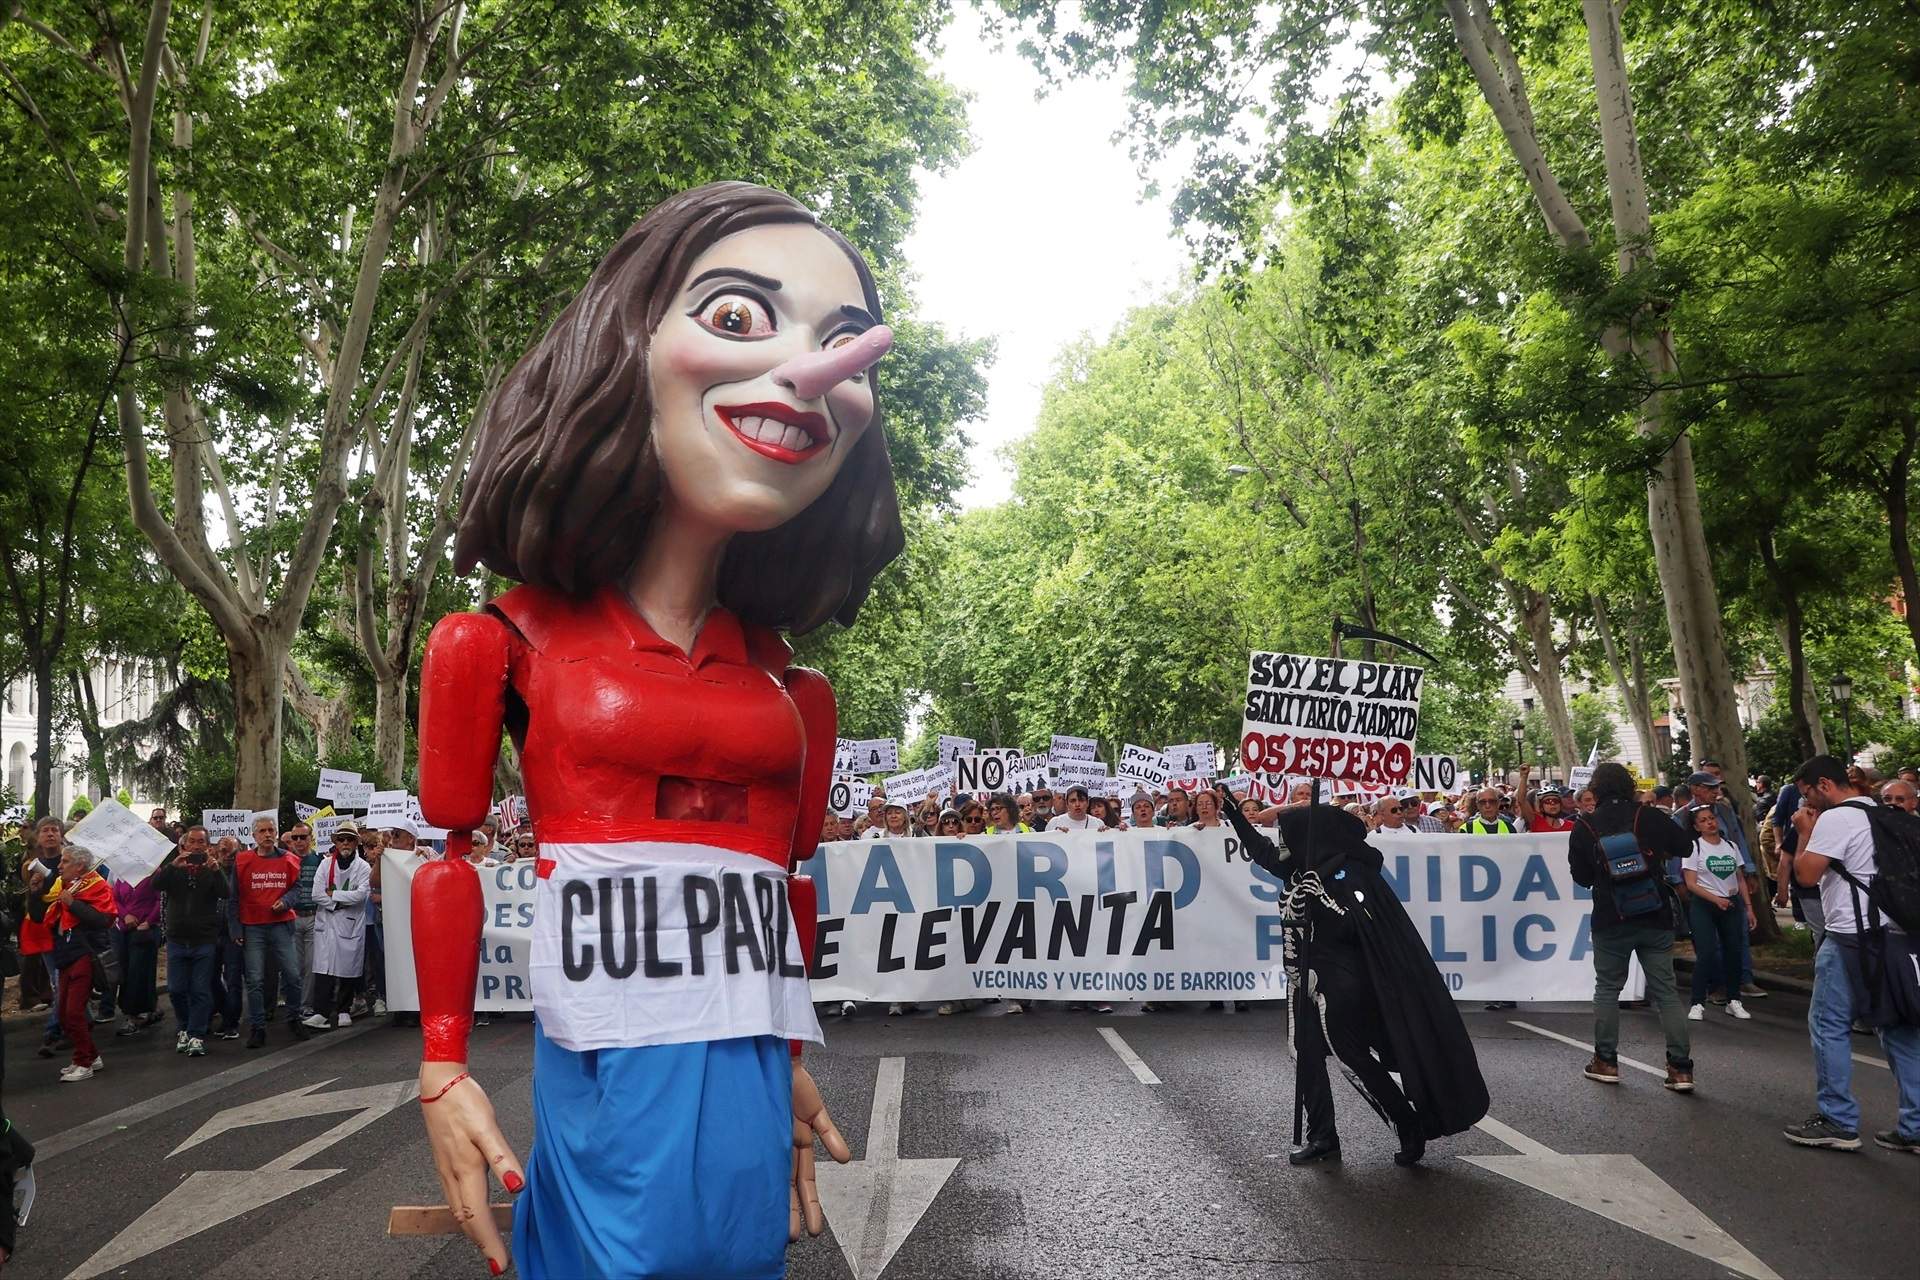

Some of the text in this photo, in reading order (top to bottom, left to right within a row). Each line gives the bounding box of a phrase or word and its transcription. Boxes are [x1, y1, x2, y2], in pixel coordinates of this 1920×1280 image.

[1250, 653, 1423, 702] SOY EL PLAN
[959, 756, 1004, 790] NO
[1119, 763, 1166, 786] SALUD!
[1122, 748, 1154, 763] ¡Por
[1157, 757, 1170, 771] la
[1241, 732, 1290, 774] OS
[1288, 737, 1412, 785] ESPERO
[1416, 757, 1455, 790] NO
[211, 813, 244, 825] Apartheid
[799, 841, 1201, 914] ADRID
[562, 873, 804, 981] CULPABL
[808, 891, 1175, 979] E LEVANTA
[480, 938, 513, 964] la
[972, 970, 1048, 990] VECINAS
[1053, 971, 1065, 990] Y
[1069, 971, 1148, 991] VECINOS
[1153, 971, 1175, 991] DE
[1181, 971, 1256, 991] BARRIOS
[1261, 971, 1272, 990] Y
